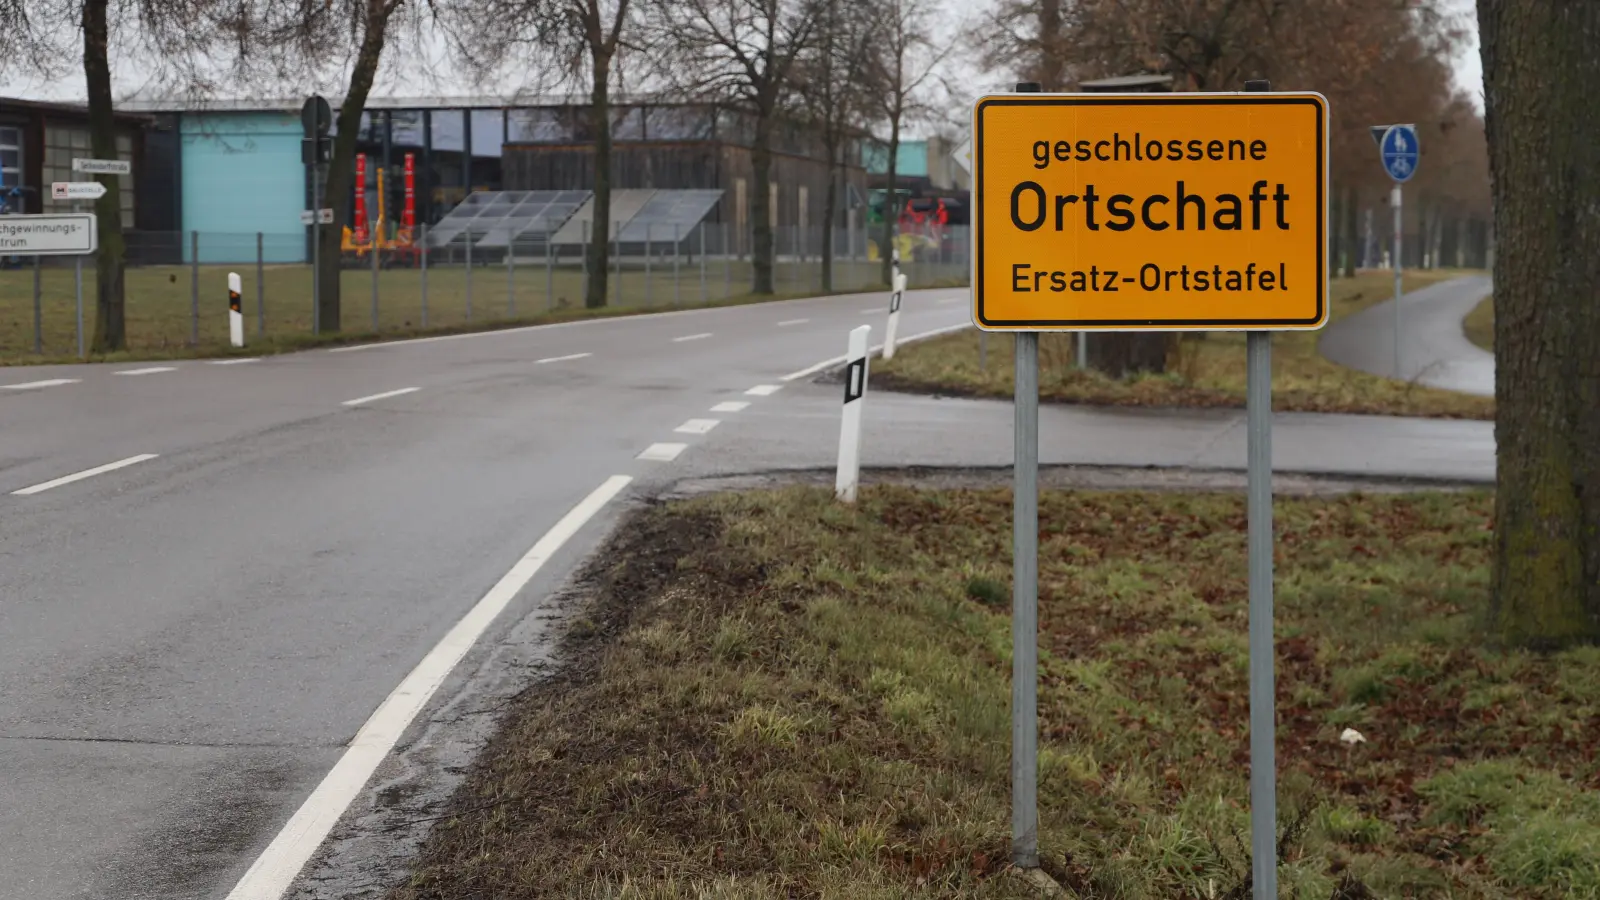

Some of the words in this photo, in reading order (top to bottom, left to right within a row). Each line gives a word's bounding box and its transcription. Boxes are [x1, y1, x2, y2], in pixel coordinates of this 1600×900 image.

[1033, 133, 1267, 169] geschlossene
[1010, 180, 1290, 232] Ortschaft
[1013, 263, 1287, 293] Ersatz-Ortstafel
